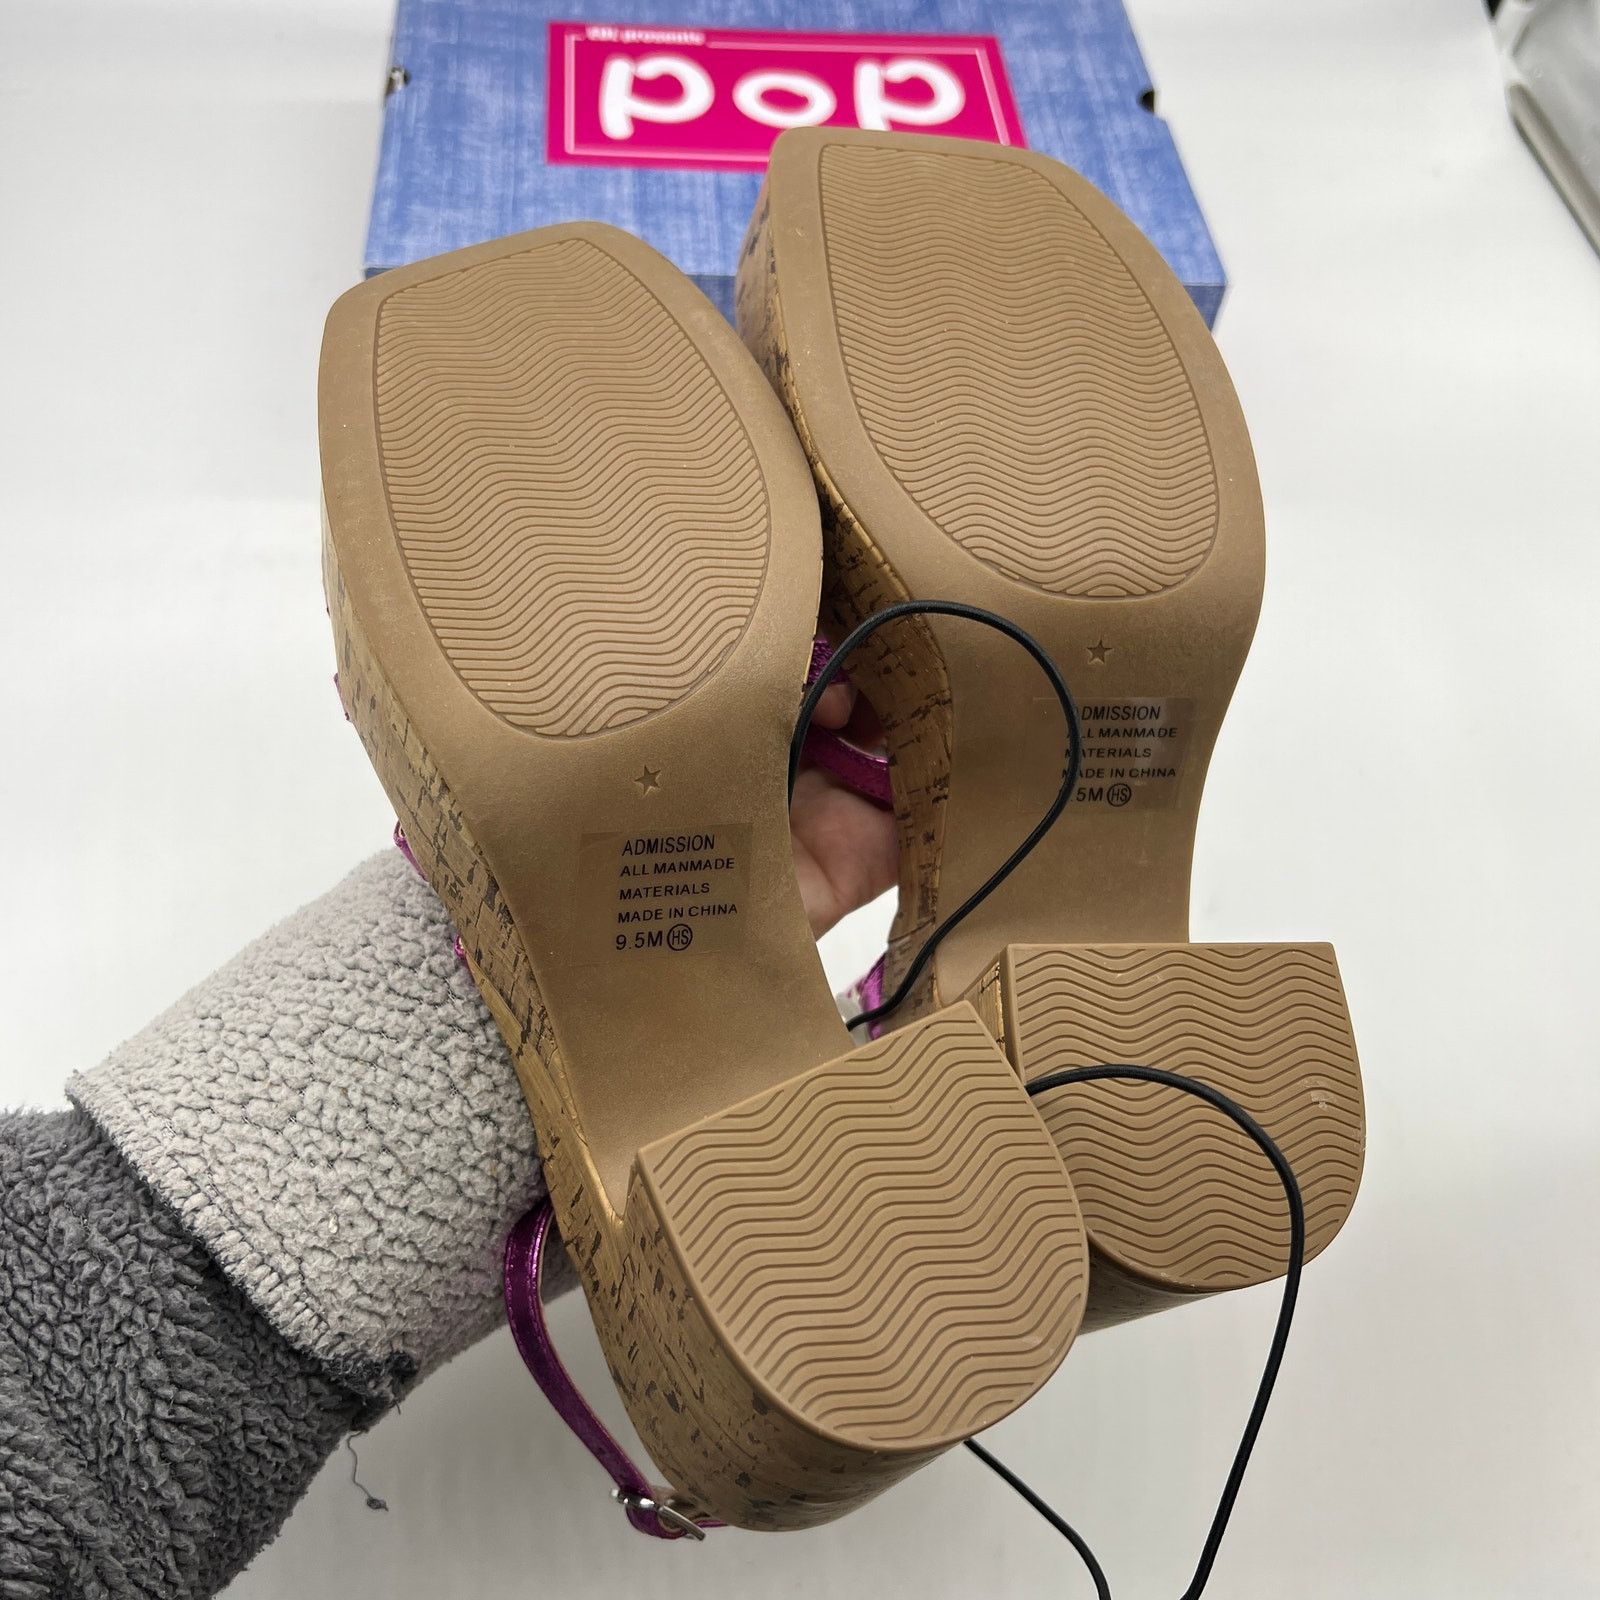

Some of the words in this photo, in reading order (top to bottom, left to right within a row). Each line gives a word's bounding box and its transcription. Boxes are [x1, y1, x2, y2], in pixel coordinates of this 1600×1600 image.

[599, 55, 967, 140] pop
[1077, 705, 1161, 721] DMISSION
[1099, 727, 1179, 739] MANMADE
[1110, 768, 1125, 779] IN
[1128, 768, 1177, 779] CHINA
[1070, 786, 1104, 803] .5M
[621, 834, 715, 856] ADMISSION
[620, 864, 650, 877] ALL
[653, 857, 736, 875] MANMADE
[619, 882, 711, 900] MATERIALS
[617, 908, 664, 923] MADE
[668, 907, 685, 919] IN
[688, 903, 738, 918] CHINA
[615, 930, 663, 951] 9.5M
